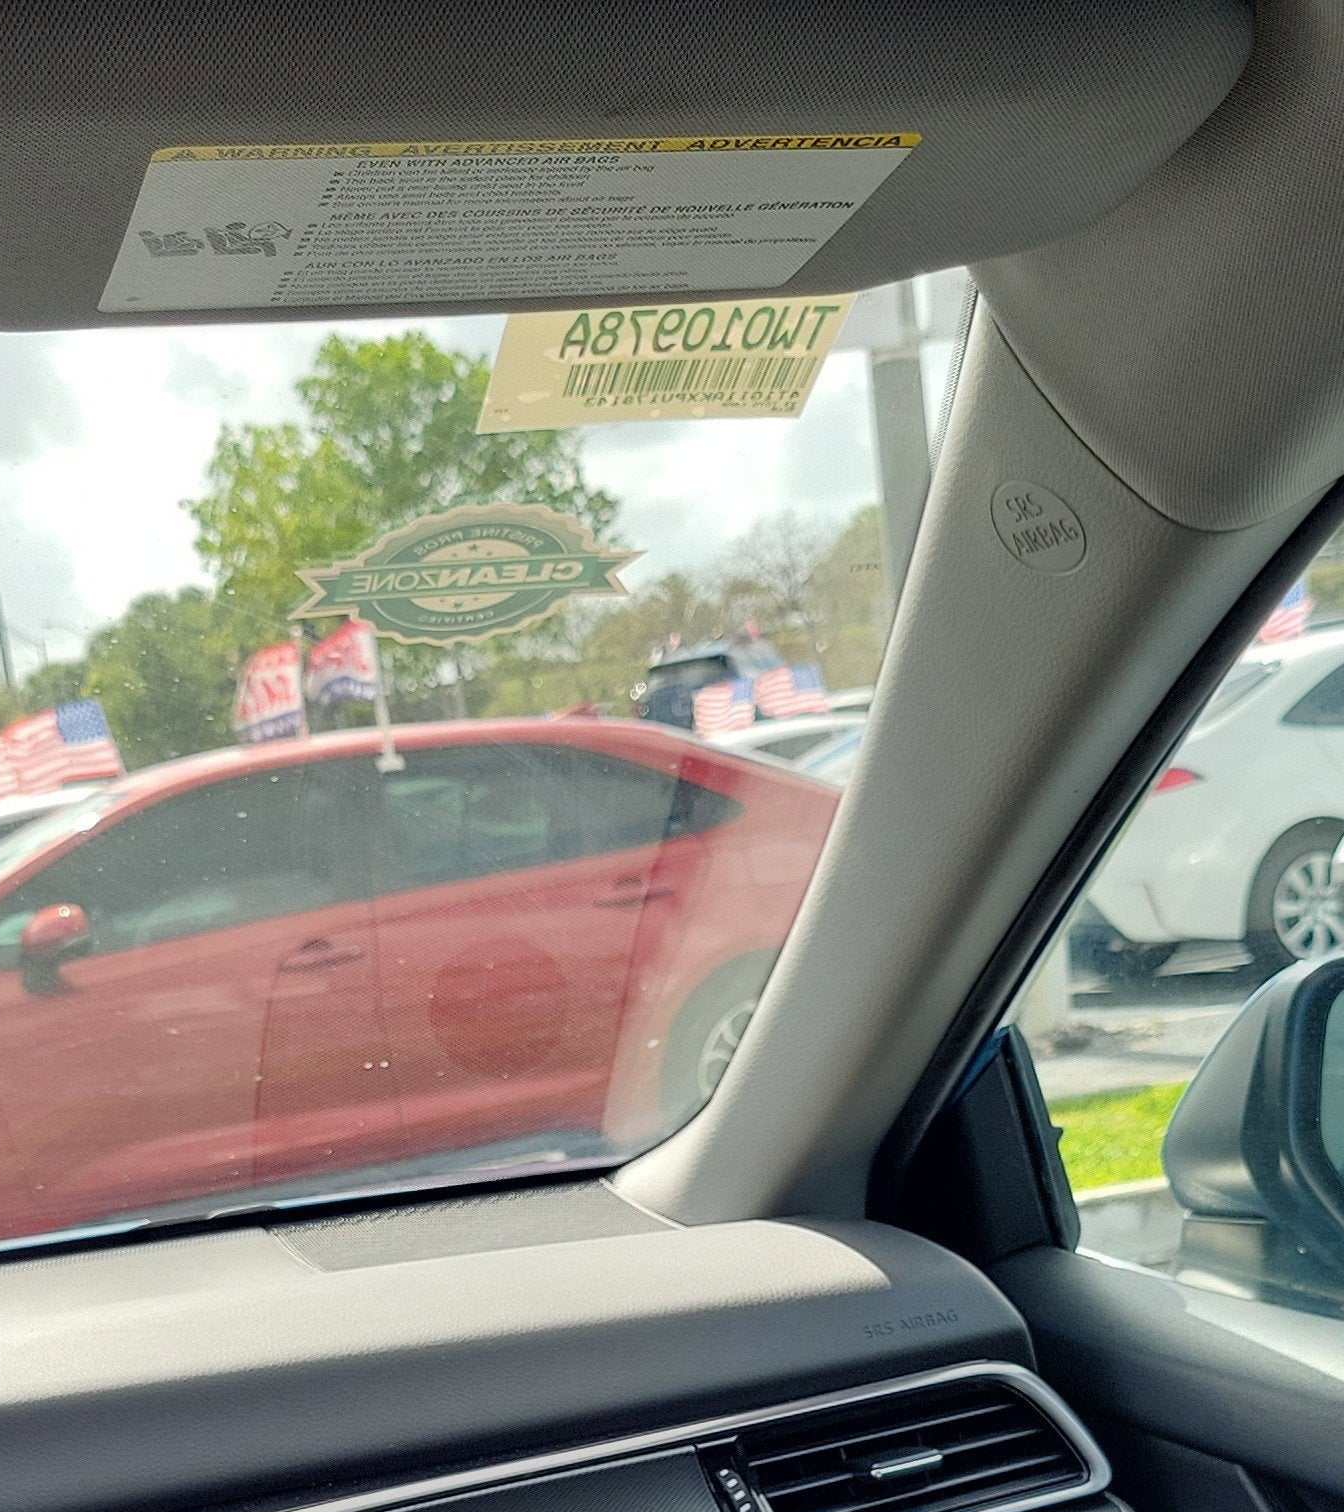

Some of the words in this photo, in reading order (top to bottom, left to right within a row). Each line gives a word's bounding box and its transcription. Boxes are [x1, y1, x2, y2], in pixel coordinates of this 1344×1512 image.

[217, 143, 373, 159] WARNING
[686, 135, 902, 151] ADVERTENCIA
[542, 156, 572, 165] AIR
[573, 155, 621, 165] BAGS
[1005, 493, 1043, 523] SRS
[862, 1321, 894, 1339] SRS
[900, 1308, 959, 1332] AIRBAG
